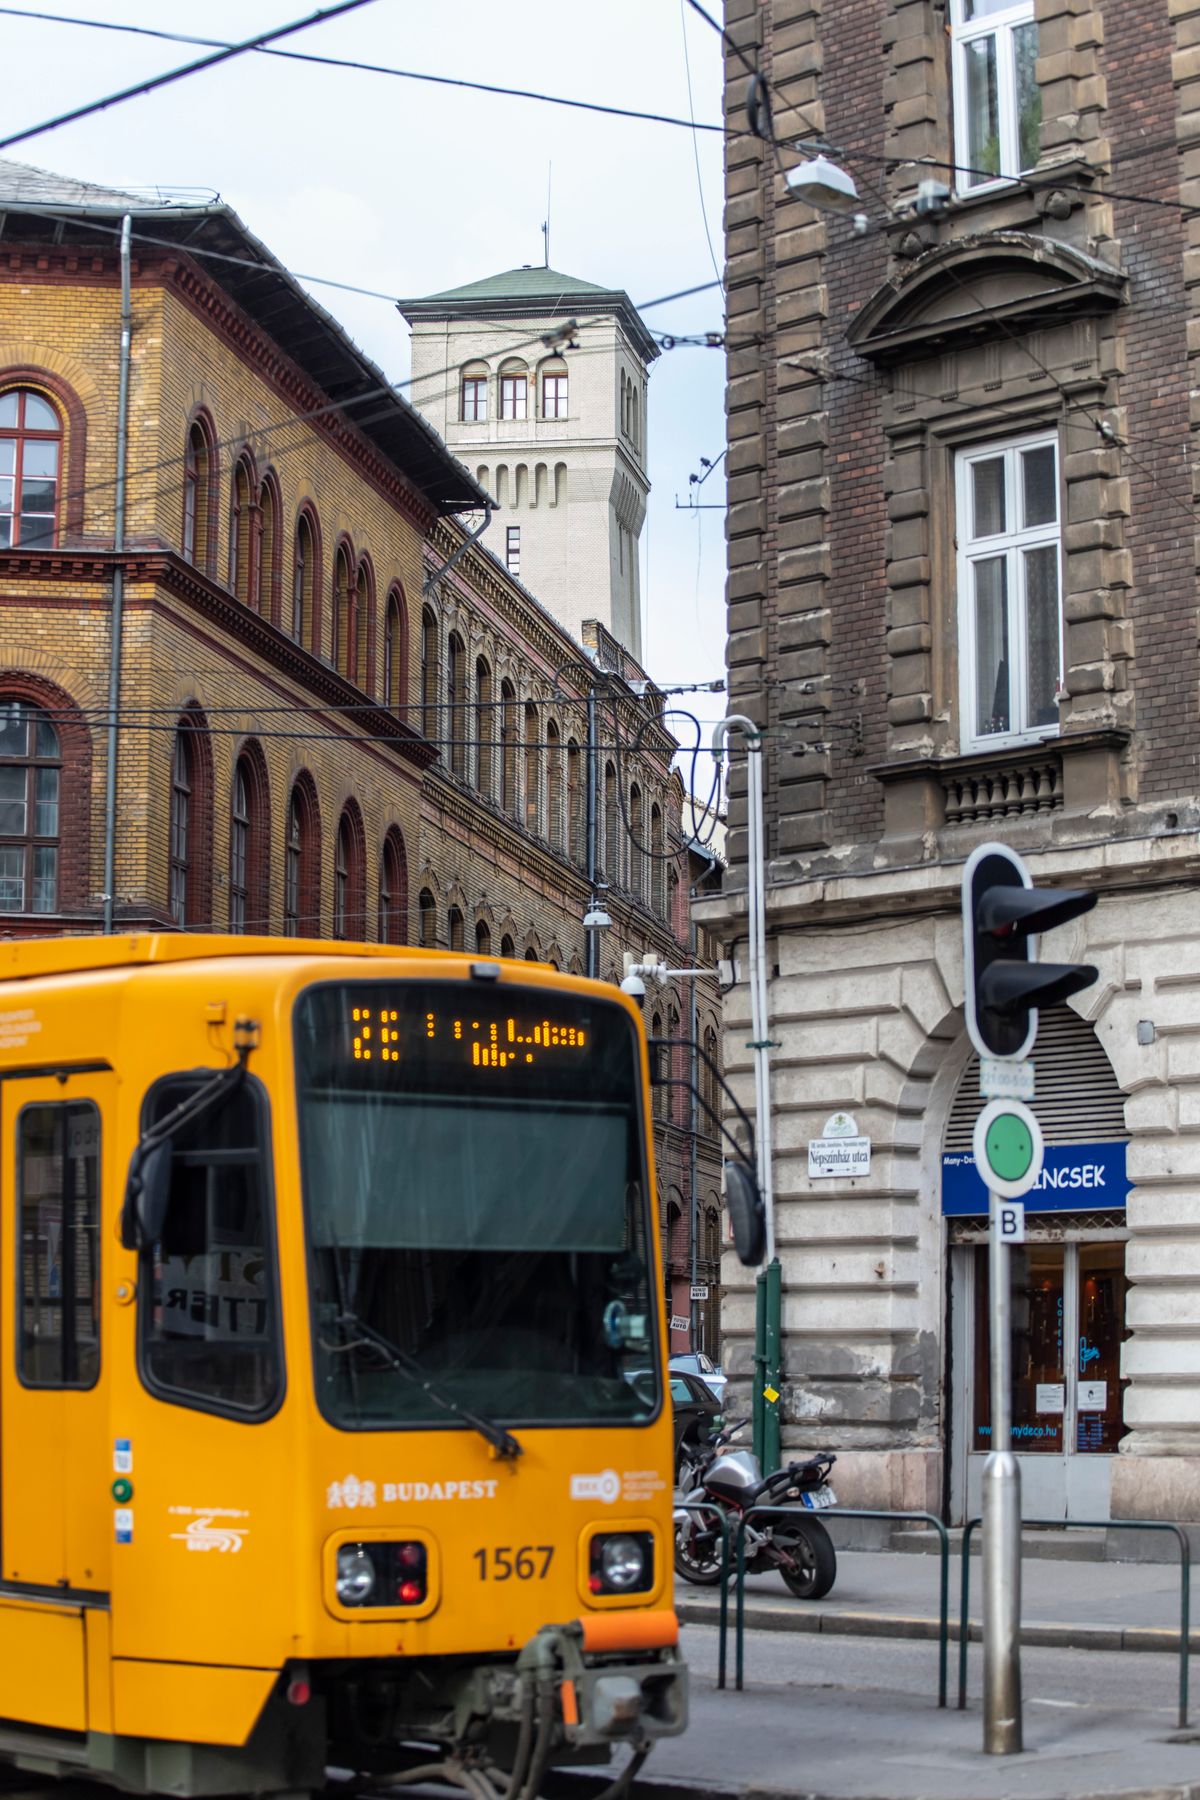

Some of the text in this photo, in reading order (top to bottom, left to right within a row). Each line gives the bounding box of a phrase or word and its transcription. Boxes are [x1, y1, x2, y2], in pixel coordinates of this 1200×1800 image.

[810, 1149, 868, 1167] Népszínház utca
[943, 1155, 976, 1167] Many-Dec
[1032, 1164, 1106, 1190] INCSEK
[1002, 1209, 1017, 1235] B
[382, 1480, 499, 1503] BUDAPEST
[472, 1546, 556, 1582] 1567
